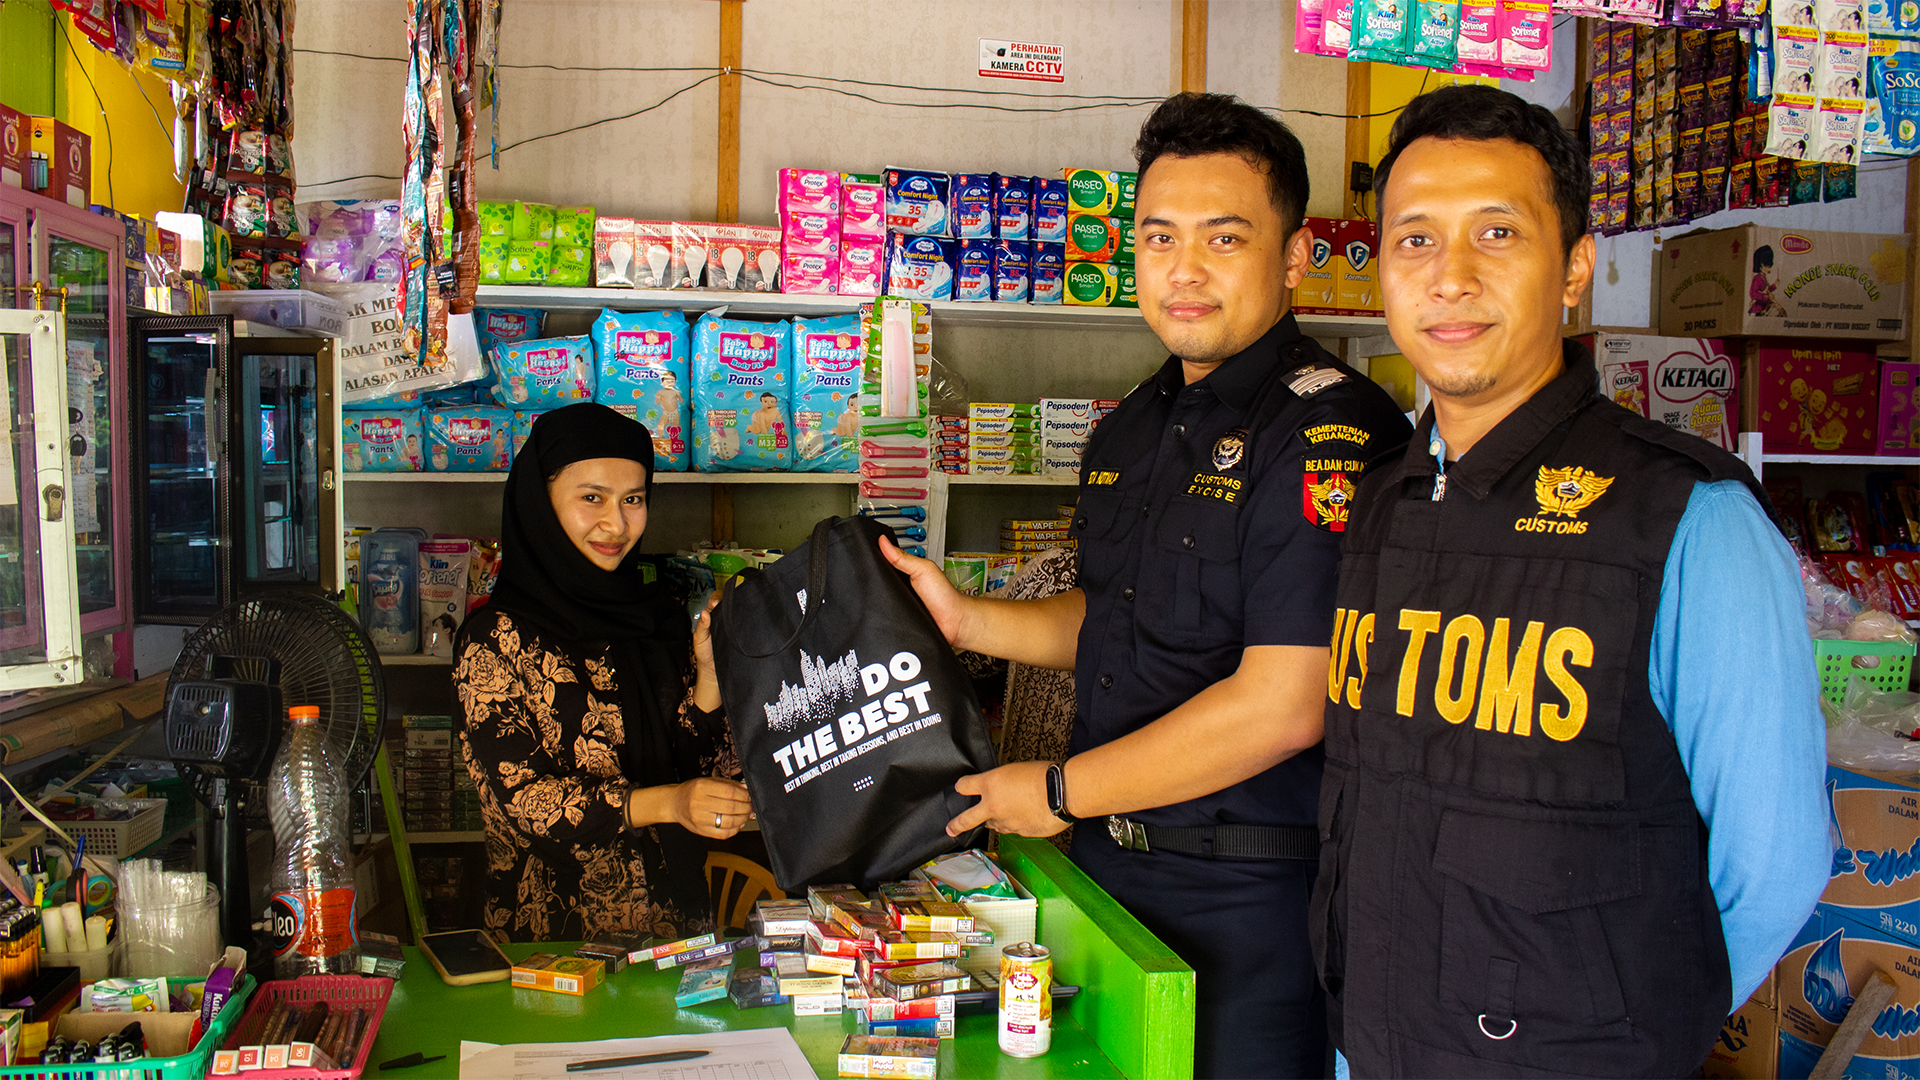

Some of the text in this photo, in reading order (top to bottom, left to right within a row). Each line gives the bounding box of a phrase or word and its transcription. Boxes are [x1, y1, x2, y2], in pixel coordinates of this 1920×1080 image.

[1378, 10, 1394, 19] Klin
[1366, 18, 1403, 32] Softener
[1432, 18, 1446, 27] Klin
[1376, 30, 1394, 39] Active
[1421, 23, 1454, 40] Softener
[1511, 27, 1541, 38] Softener
[1430, 38, 1445, 46] Active
[1010, 43, 1062, 54] PERHATIAN!
[1024, 52, 1032, 60] INI
[1033, 53, 1062, 62] DILENGKAPI
[990, 60, 1062, 74] KAMERA CCTV
[1072, 180, 1103, 190] PASEO
[854, 194, 873, 202] Protex
[898, 190, 938, 200] Comfort Night
[908, 205, 922, 216] 35
[970, 204, 980, 212] 35
[1074, 224, 1104, 234] PASEO
[710, 248, 719, 259] 18
[747, 250, 756, 261] 18
[902, 250, 944, 261] Comfort Night
[914, 266, 928, 278] 35
[970, 266, 980, 274] 35
[1304, 271, 1332, 280] Formula
[1071, 274, 1102, 284] PASEO
[1344, 273, 1370, 282] Formula
[1784, 264, 1881, 302] MONDE SNACK GOLD
[1684, 319, 1717, 332] 30 PACKS
[620, 336, 642, 346] Baby
[723, 338, 747, 349] Baby
[810, 339, 834, 350] Baby
[342, 340, 388, 359] DALAM
[619, 341, 669, 354] Happy!
[722, 344, 774, 360] Happy!
[810, 344, 860, 360] Happy!
[1792, 349, 1842, 361] Upin Ipin
[529, 358, 567, 369] Happy!
[730, 360, 750, 370] Body
[1827, 364, 1840, 372] NET
[626, 368, 660, 380] Pants
[1661, 368, 1728, 388] KETAGI
[344, 370, 398, 392] ALASAN
[728, 374, 765, 386] Pants
[815, 374, 852, 387] Pants
[1615, 374, 1639, 386] KETAGI
[1046, 400, 1090, 411] Pepsodent
[1692, 403, 1720, 416] Ayam
[976, 422, 1006, 430] Pepsodent
[1046, 420, 1089, 430] Pepsodent
[1690, 413, 1723, 428] Goreng
[1304, 424, 1370, 441] KEMENTERIAN
[1310, 434, 1366, 446] KEUANGAN
[370, 446, 394, 454] Pants
[456, 447, 482, 456] Pants
[978, 450, 1006, 458] Pepsodent
[1046, 458, 1081, 469] Pepsode
[1306, 460, 1366, 472] BEA DAN CUKA
[1194, 472, 1242, 490] CUSTOMS
[1188, 484, 1236, 503] EXCISE
[1032, 522, 1054, 530] VAPE
[1515, 517, 1589, 534] CUSTOMS
[1034, 532, 1057, 540] VAPE
[430, 558, 449, 569] Klin
[419, 568, 462, 586] oftener
[860, 652, 922, 697] DO
[1396, 608, 1594, 742] TOMS
[772, 680, 932, 778] THE BEST
[839, 748, 858, 764] TAKING
[856, 735, 888, 756] DECISIONS,
[886, 729, 900, 742] AND
[898, 724, 915, 738] BEST
[914, 720, 922, 730] IN
[922, 712, 942, 728] DOING
[1900, 796, 1917, 808] AIR
[1888, 804, 1919, 820] DALAM
[1894, 917, 1918, 936] 220
[656, 946, 671, 954] ESSE
[678, 954, 690, 963] ESSE
[1894, 961, 1920, 980] DALA
